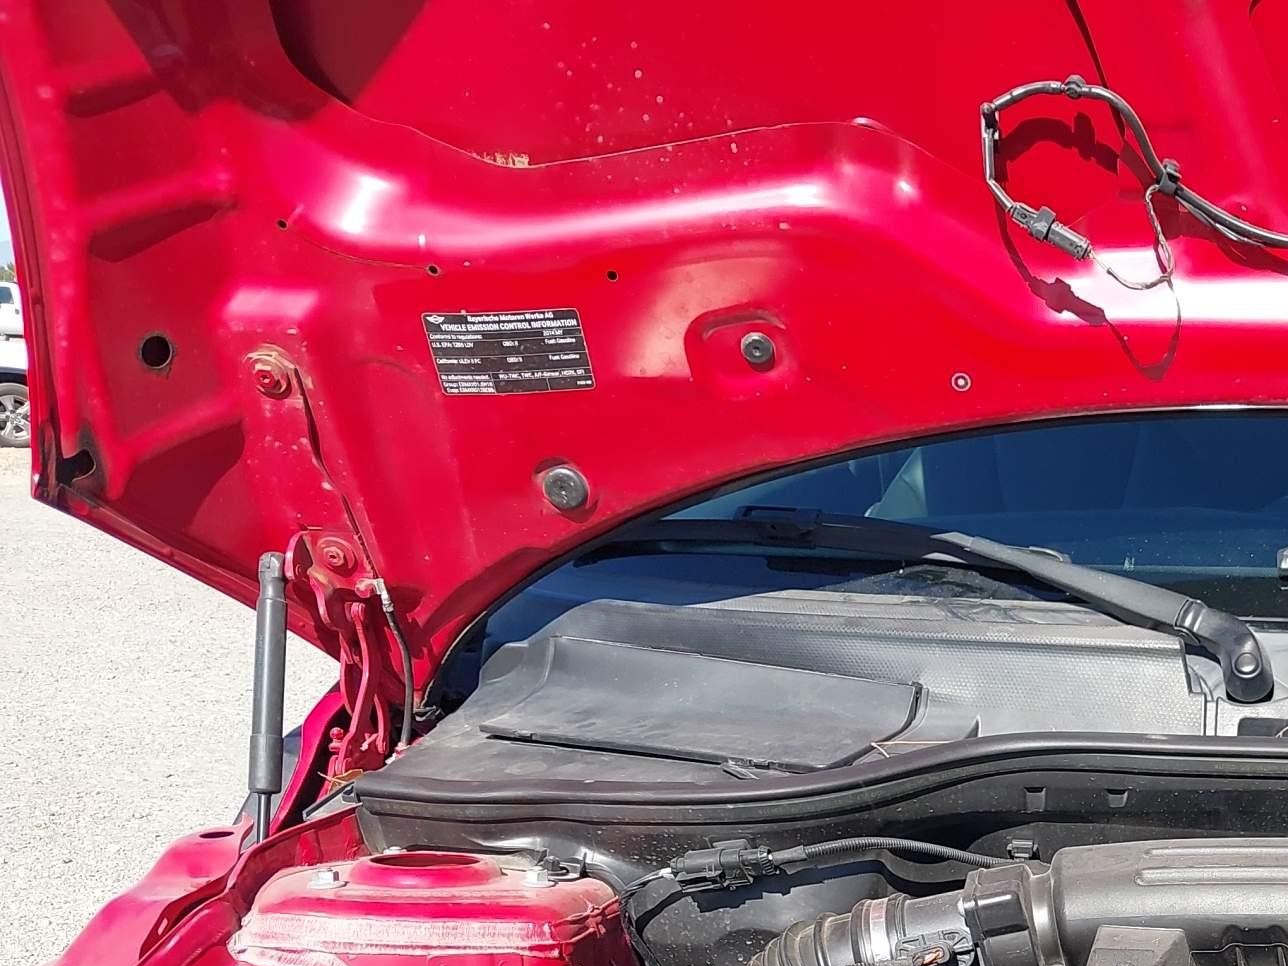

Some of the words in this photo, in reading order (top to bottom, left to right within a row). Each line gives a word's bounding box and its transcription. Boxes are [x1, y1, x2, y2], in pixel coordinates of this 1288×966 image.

[440, 323, 467, 331] VEHICLE
[467, 322, 499, 331] EMISSION
[500, 321, 531, 330] CONTROL
[531, 318, 577, 328] INFORMATION
